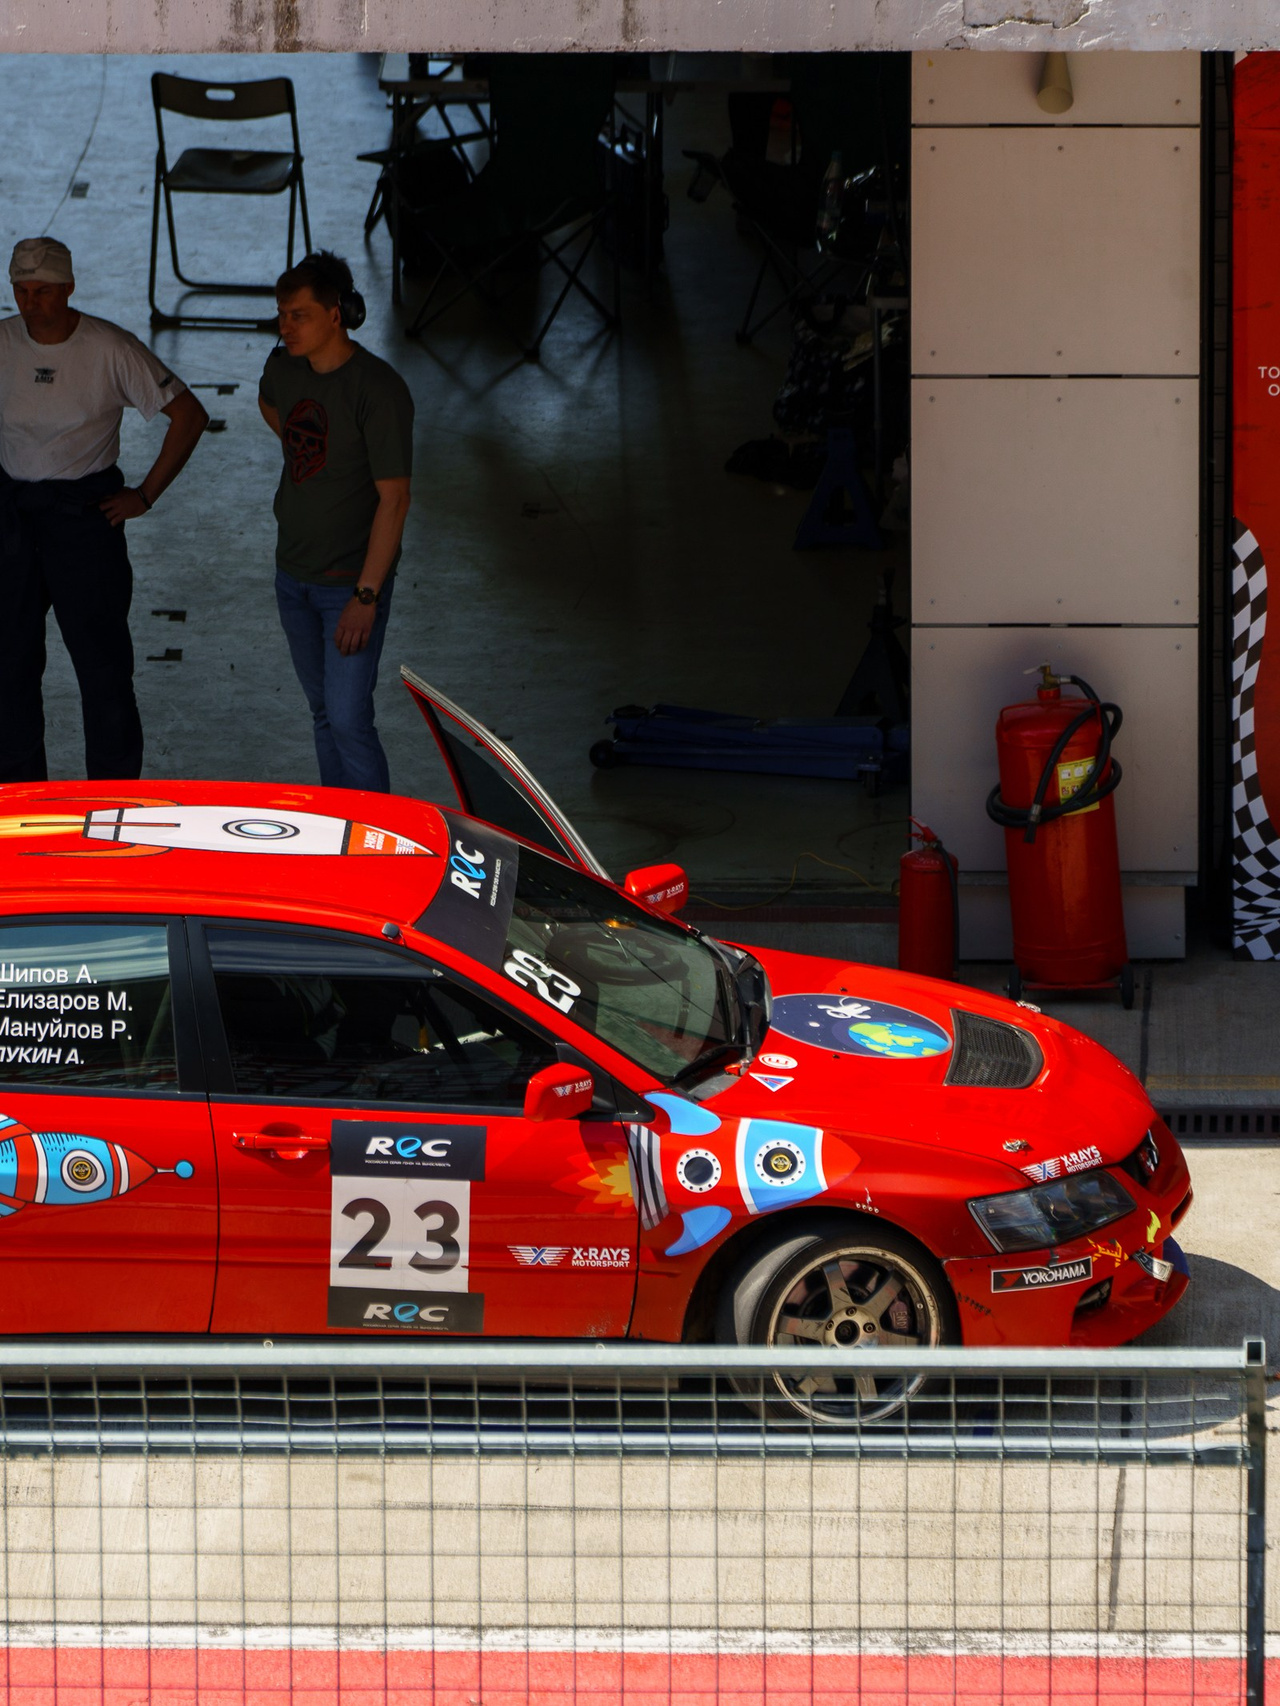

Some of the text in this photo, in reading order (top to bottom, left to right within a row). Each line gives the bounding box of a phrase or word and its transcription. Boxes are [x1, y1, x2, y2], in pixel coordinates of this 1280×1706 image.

[75, 964, 98, 984] А.
[503, 949, 582, 1014] 23
[107, 990, 133, 1012] М.
[111, 1019, 133, 1040] Р.
[64, 1048, 85, 1065] А.
[1060, 1145, 1102, 1168] X-RAYS
[1066, 1156, 1104, 1173] MOTORSPORT
[338, 1196, 461, 1275] 23
[571, 1259, 630, 1268] MOTORSPORT
[572, 1246, 631, 1261] X-RAYS
[1021, 1262, 1087, 1286] YOKOHAMA
